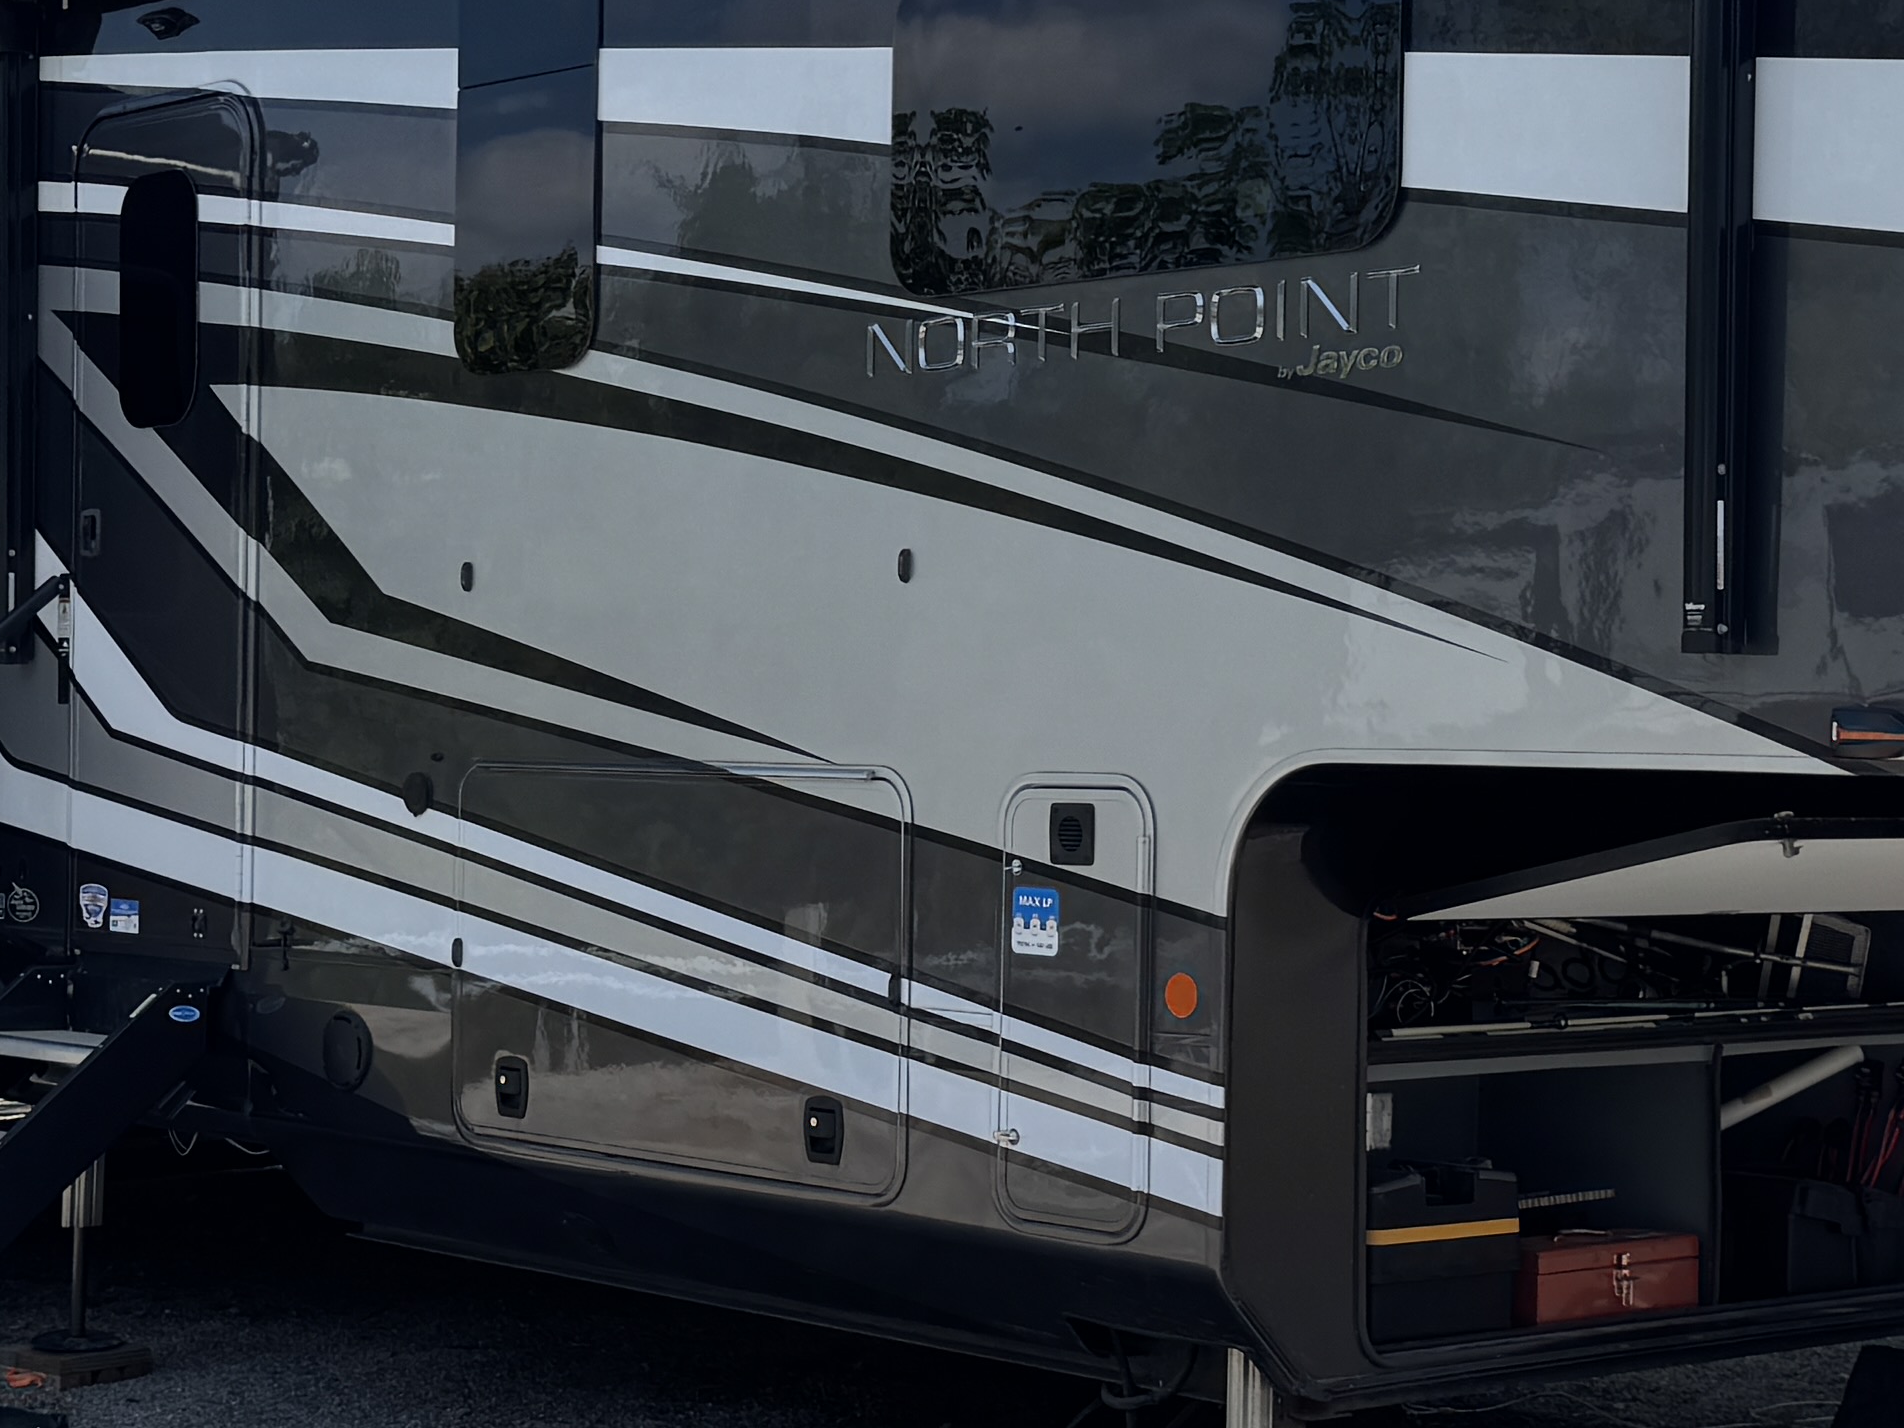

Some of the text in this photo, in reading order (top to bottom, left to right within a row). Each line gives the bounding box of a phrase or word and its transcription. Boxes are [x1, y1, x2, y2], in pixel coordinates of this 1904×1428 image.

[866, 264, 1421, 379] NORTH POINT
[1277, 344, 1404, 380] by Jayco
[1019, 895, 1053, 908] MAX LP
